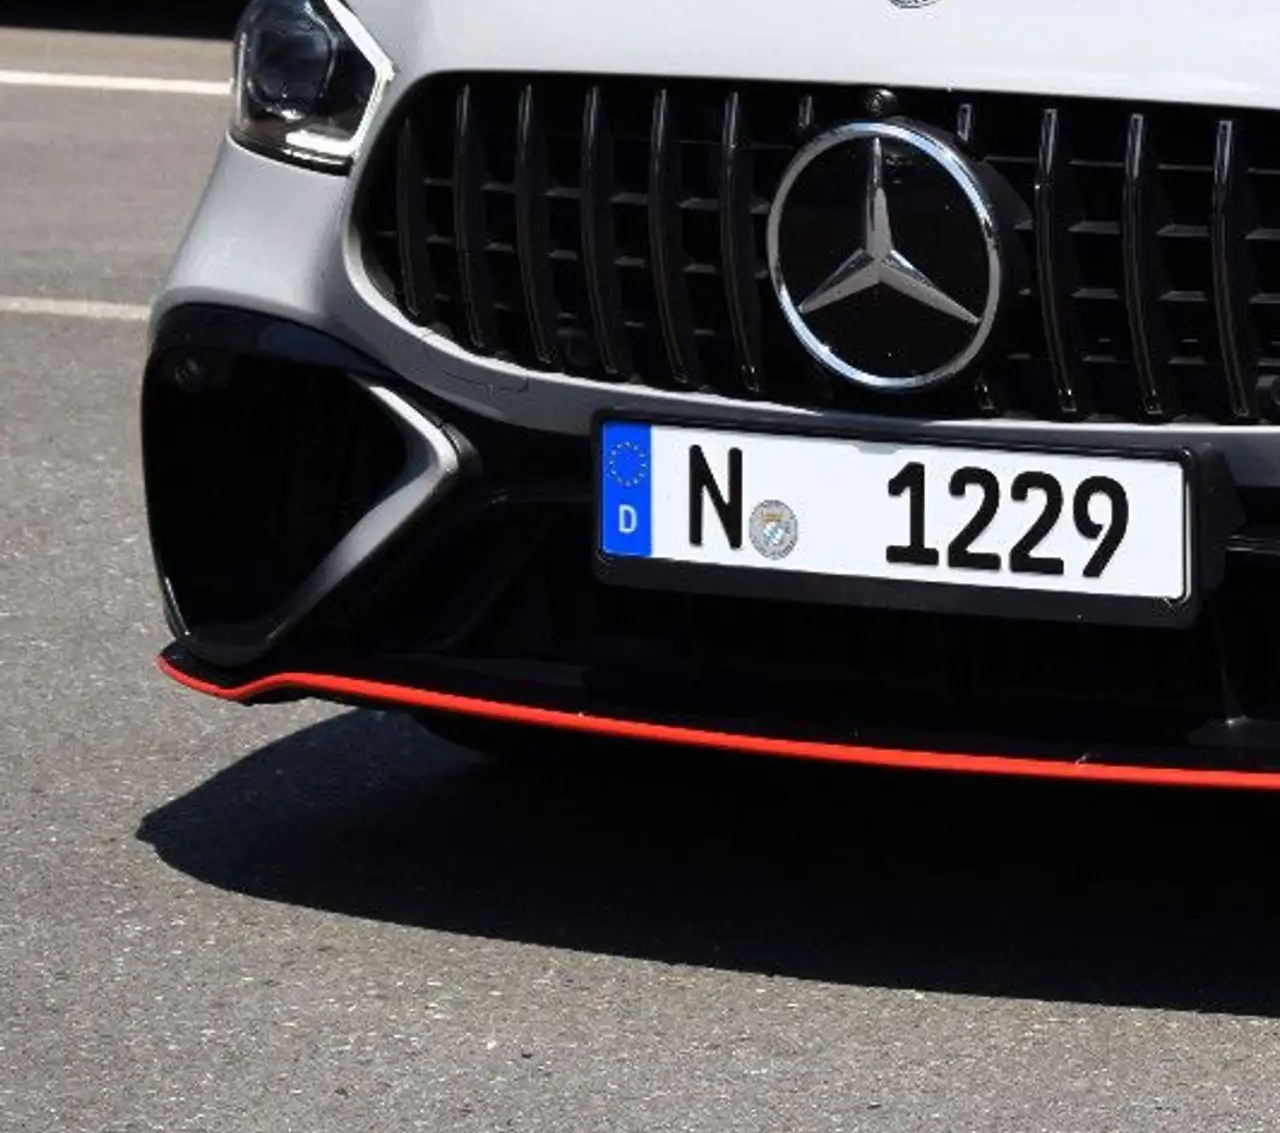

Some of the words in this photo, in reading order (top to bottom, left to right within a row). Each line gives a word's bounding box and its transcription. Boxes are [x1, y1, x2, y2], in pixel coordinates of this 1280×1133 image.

[618, 503, 638, 534] D
[688, 444, 743, 549] N
[886, 461, 1130, 579] 1229
